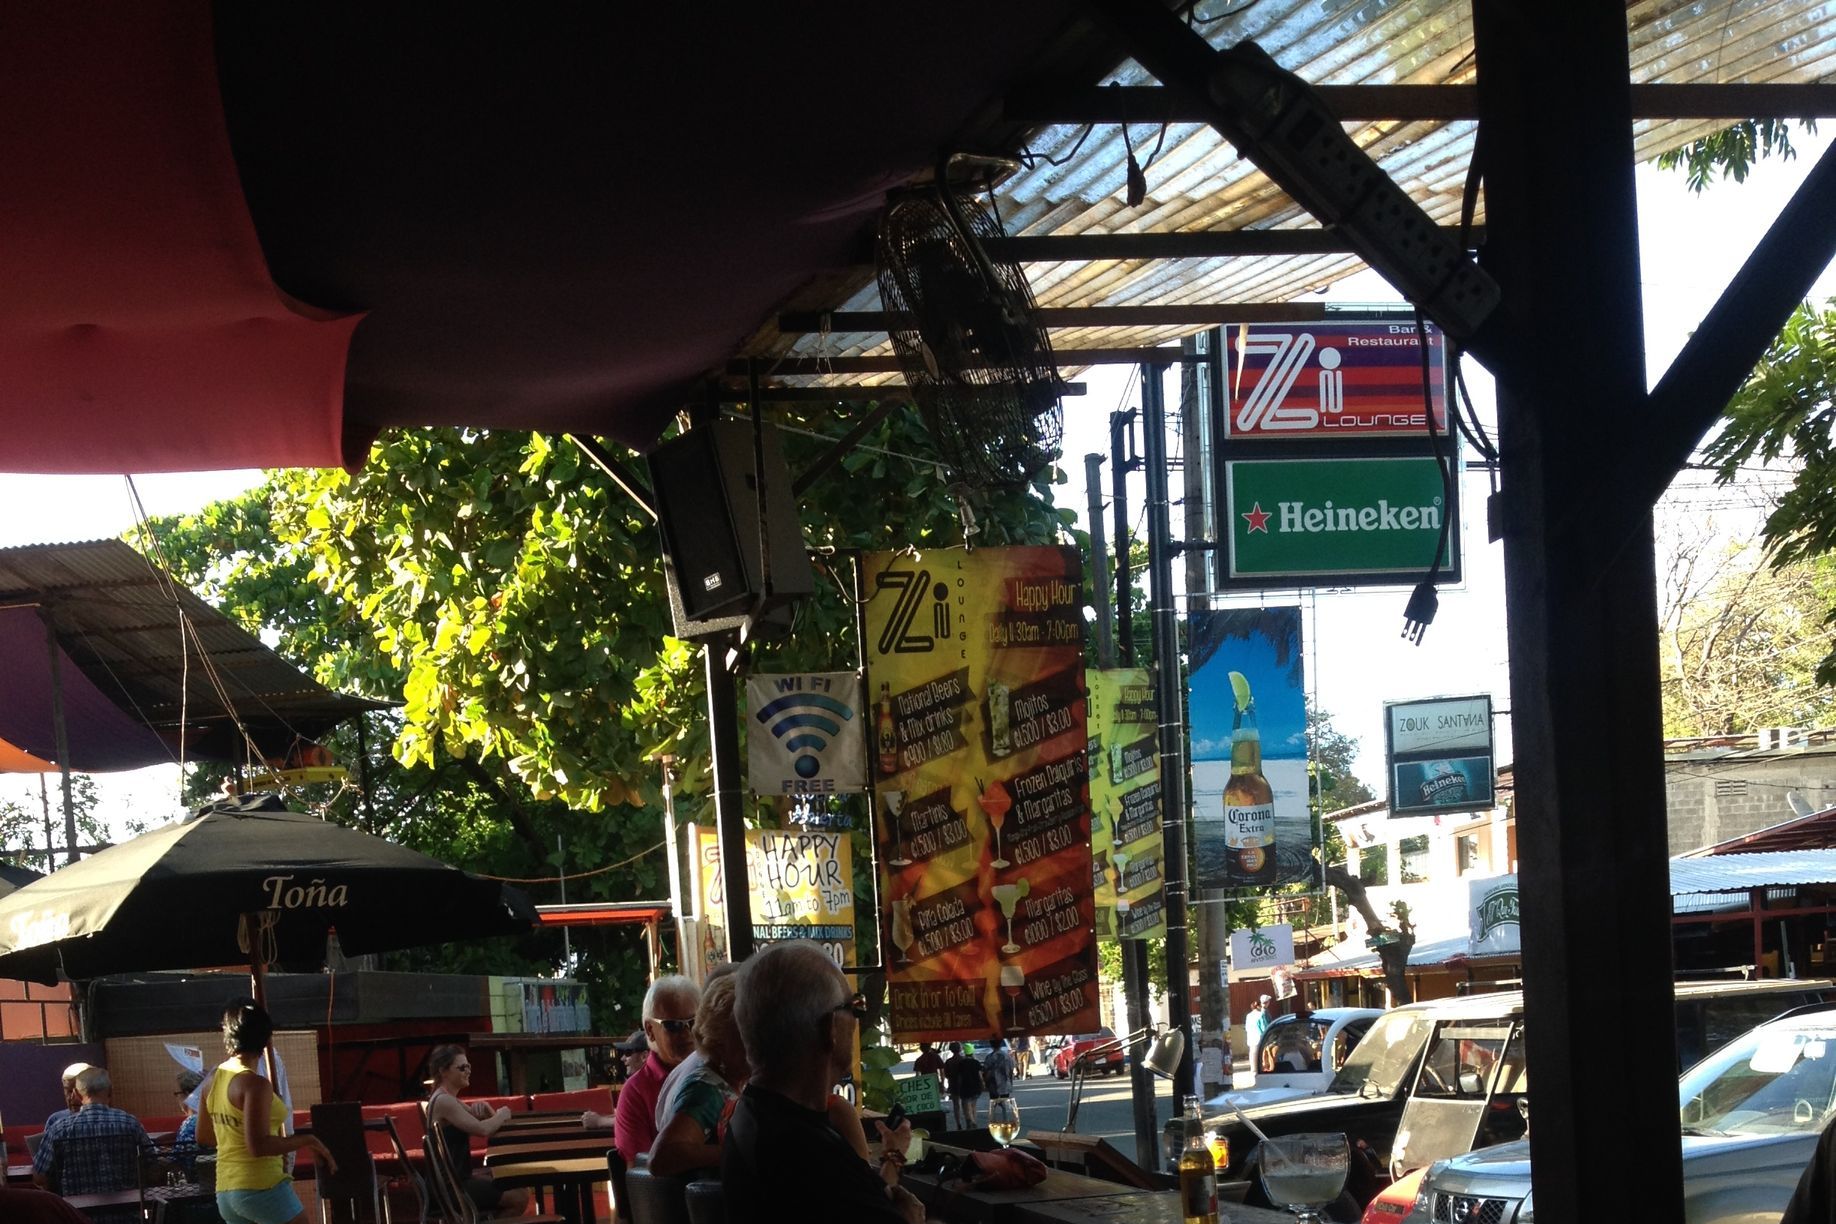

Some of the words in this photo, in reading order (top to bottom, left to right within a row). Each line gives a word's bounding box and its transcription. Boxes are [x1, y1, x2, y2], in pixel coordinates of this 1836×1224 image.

[1347, 336, 1434, 347] Restaurat
[1389, 324, 1415, 334] Bar
[1235, 333, 1343, 432] Zi
[1323, 414, 1427, 428] LOUNGE
[1278, 500, 1441, 533] Heineken
[1016, 581, 1049, 612] Happy
[1051, 579, 1077, 606] Hour
[876, 569, 951, 655] Zi
[773, 676, 803, 693] WI
[811, 677, 832, 692] FI
[898, 684, 933, 716] National
[931, 678, 961, 702] Beers
[1014, 693, 1049, 722] Mojitos
[907, 717, 925, 740] Mix
[925, 706, 954, 733] drinks
[1400, 717, 1430, 732] ZOUK
[781, 779, 836, 794] FREE
[1014, 771, 1048, 799] Frozen
[910, 804, 948, 833] Martinis
[1015, 804, 1025, 825] &
[1023, 787, 1073, 821] Margaritas
[1228, 808, 1271, 824] Corona
[1239, 823, 1265, 834] Extra
[762, 834, 839, 862] HAPPY
[767, 859, 842, 890] HOUR
[262, 874, 349, 910] Toña
[766, 897, 804, 920] 11am
[807, 896, 820, 912] to
[822, 890, 851, 913] 7pm
[1025, 886, 1074, 919] Margaritas
[936, 897, 965, 923] Colada
[772, 926, 798, 941] BEERS
[824, 925, 853, 940] DRINKS
[1028, 980, 1053, 1001] Wine
